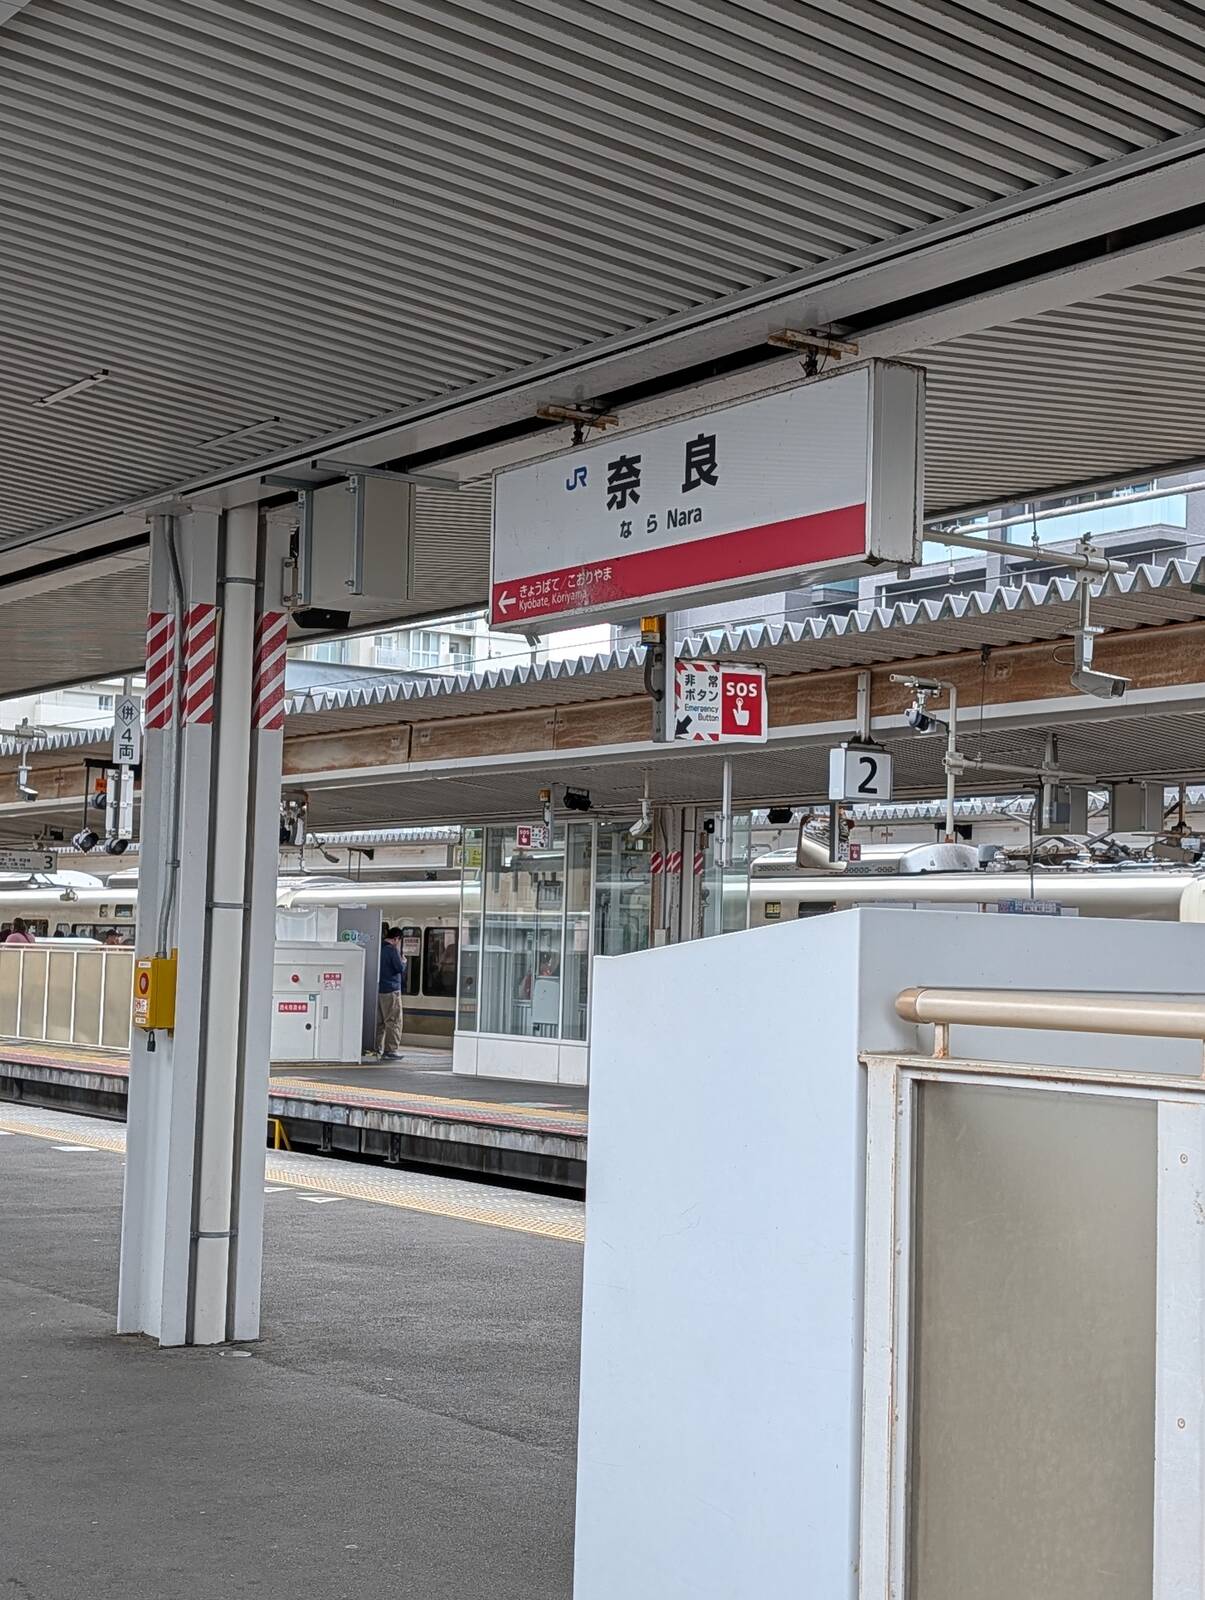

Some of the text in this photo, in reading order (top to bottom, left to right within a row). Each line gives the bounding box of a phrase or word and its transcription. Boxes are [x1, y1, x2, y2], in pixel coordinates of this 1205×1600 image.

[565, 466, 588, 491] JR
[606, 433, 719, 511] 奈良
[620, 507, 702, 539] なら Nara
[684, 673, 719, 689] 非常
[726, 681, 758, 697] SOS
[685, 688, 719, 702] ボタン
[684, 703, 719, 713] Emergency
[697, 712, 720, 722] Button
[857, 756, 878, 794] 2
[43, 855, 53, 870] 3
